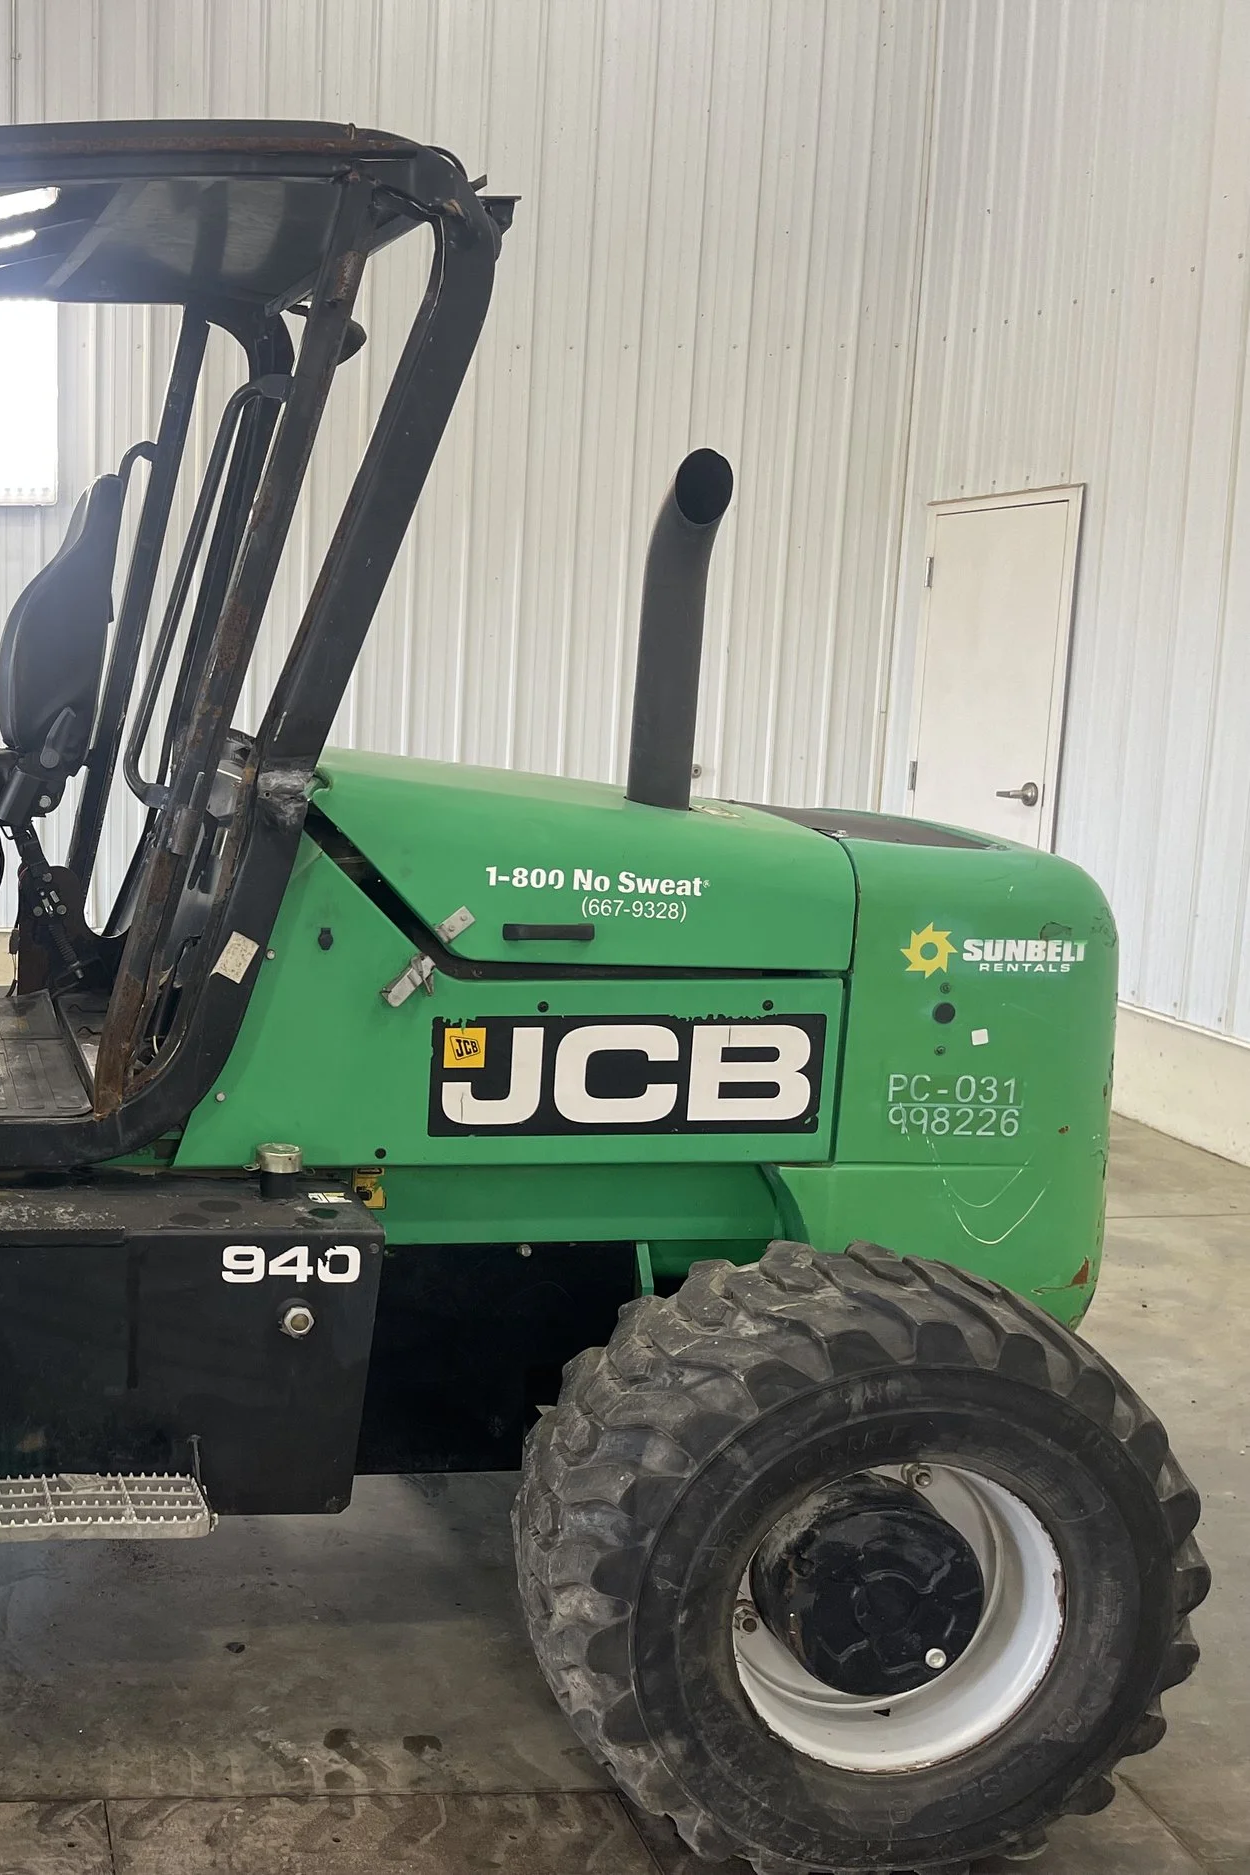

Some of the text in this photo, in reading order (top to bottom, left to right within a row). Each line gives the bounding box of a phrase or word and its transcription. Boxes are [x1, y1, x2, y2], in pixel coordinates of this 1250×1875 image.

[485, 866, 565, 889] 1-800
[573, 868, 610, 892] No
[581, 896, 687, 923] (667-9328)
[962, 939, 1088, 962] SUNBELT
[979, 963, 1071, 973] RENTALS
[455, 1038, 479, 1057] JCB
[441, 1024, 811, 1125] JCB
[888, 1074, 1016, 1104] PC-031
[888, 1106, 1019, 1137] 998226
[221, 1245, 361, 1283] 940
